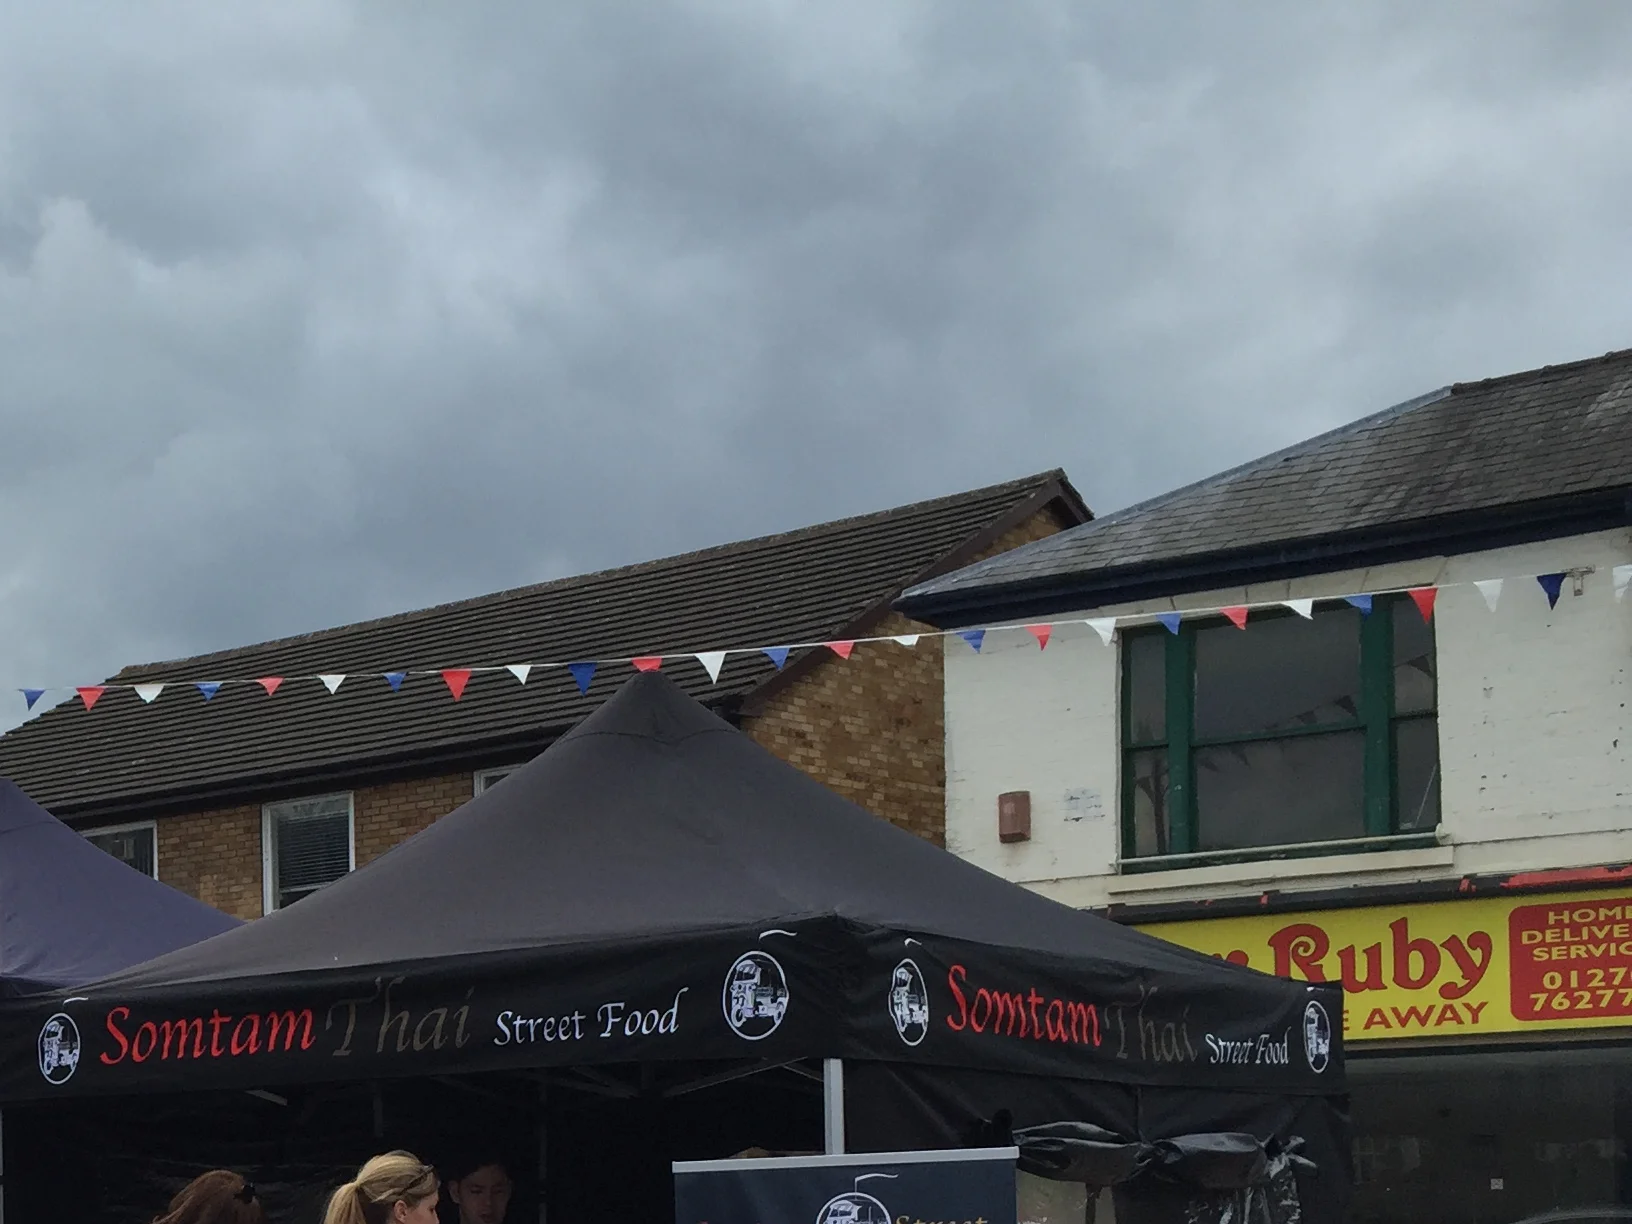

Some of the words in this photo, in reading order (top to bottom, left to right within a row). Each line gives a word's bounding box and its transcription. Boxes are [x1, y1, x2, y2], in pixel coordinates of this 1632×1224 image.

[1268, 916, 1493, 1000] Ruby
[1542, 967, 1632, 990] 0127
[99, 1005, 317, 1066] Somtam
[325, 976, 474, 1058] Thai
[494, 1010, 587, 1048] Street
[597, 986, 688, 1038] Food
[947, 964, 1102, 1047] Somtam
[1104, 982, 1198, 1062] Thai
[1205, 1033, 1252, 1064] Street
[1254, 1027, 1291, 1065] Food
[1363, 1001, 1489, 1030] AWAY
